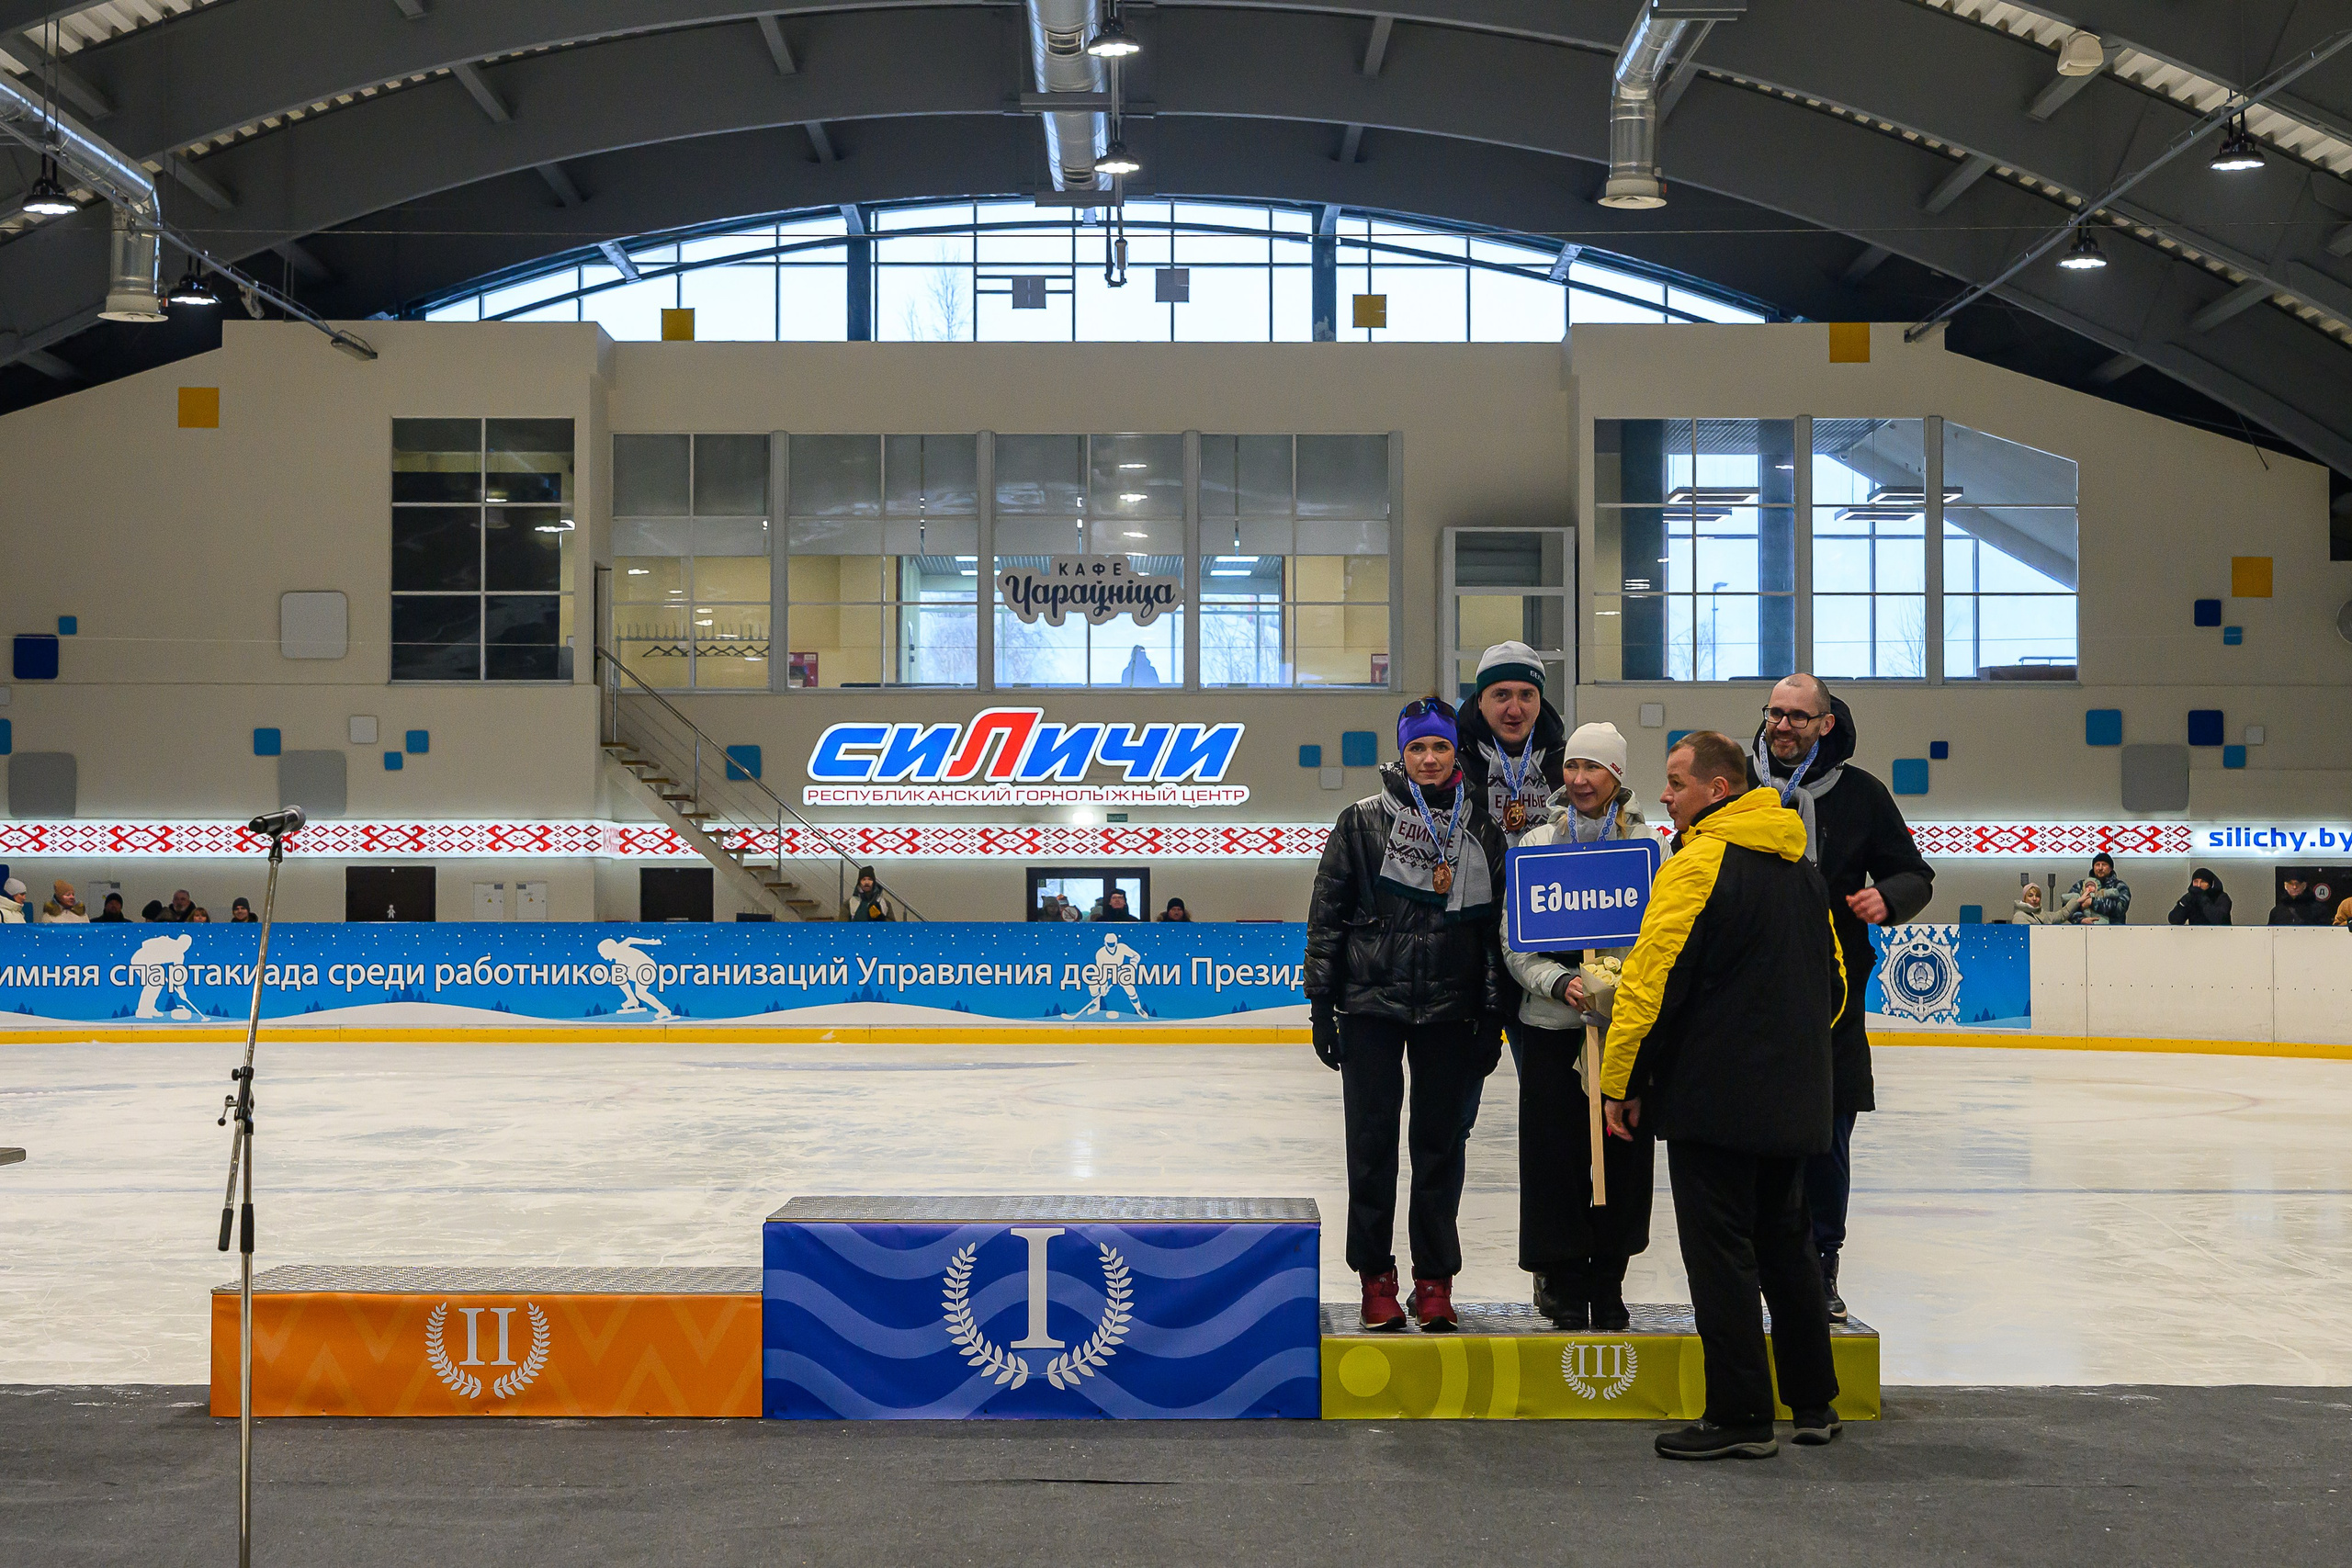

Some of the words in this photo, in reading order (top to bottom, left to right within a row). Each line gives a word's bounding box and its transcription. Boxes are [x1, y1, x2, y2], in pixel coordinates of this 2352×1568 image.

[1058, 562, 1122, 577] КАФЕ
[1005, 575, 1176, 619] Чараўніца
[809, 709, 1243, 780] СИЛИЧИ
[807, 787, 1011, 802] РЕСПУБЛИКАНСКИЙ
[1015, 787, 1177, 802] ГОРНОЛЫЖНЫЙ
[1182, 789, 1246, 805] ЦЕНТР
[1495, 793, 1546, 809] ЕДНЫЕ
[2209, 827, 2352, 852] silichy.by
[1530, 881, 1639, 914] Единые
[109, 964, 319, 993] спартакиада
[327, 963, 425, 993] среди
[434, 954, 629, 993] работников
[635, 956, 849, 993] организаций
[856, 956, 1052, 993] Управления
[1060, 963, 1182, 991] делами
[1010, 1227, 1066, 1348] I
[458, 1307, 517, 1366] II
[1573, 1345, 1626, 1378] III
